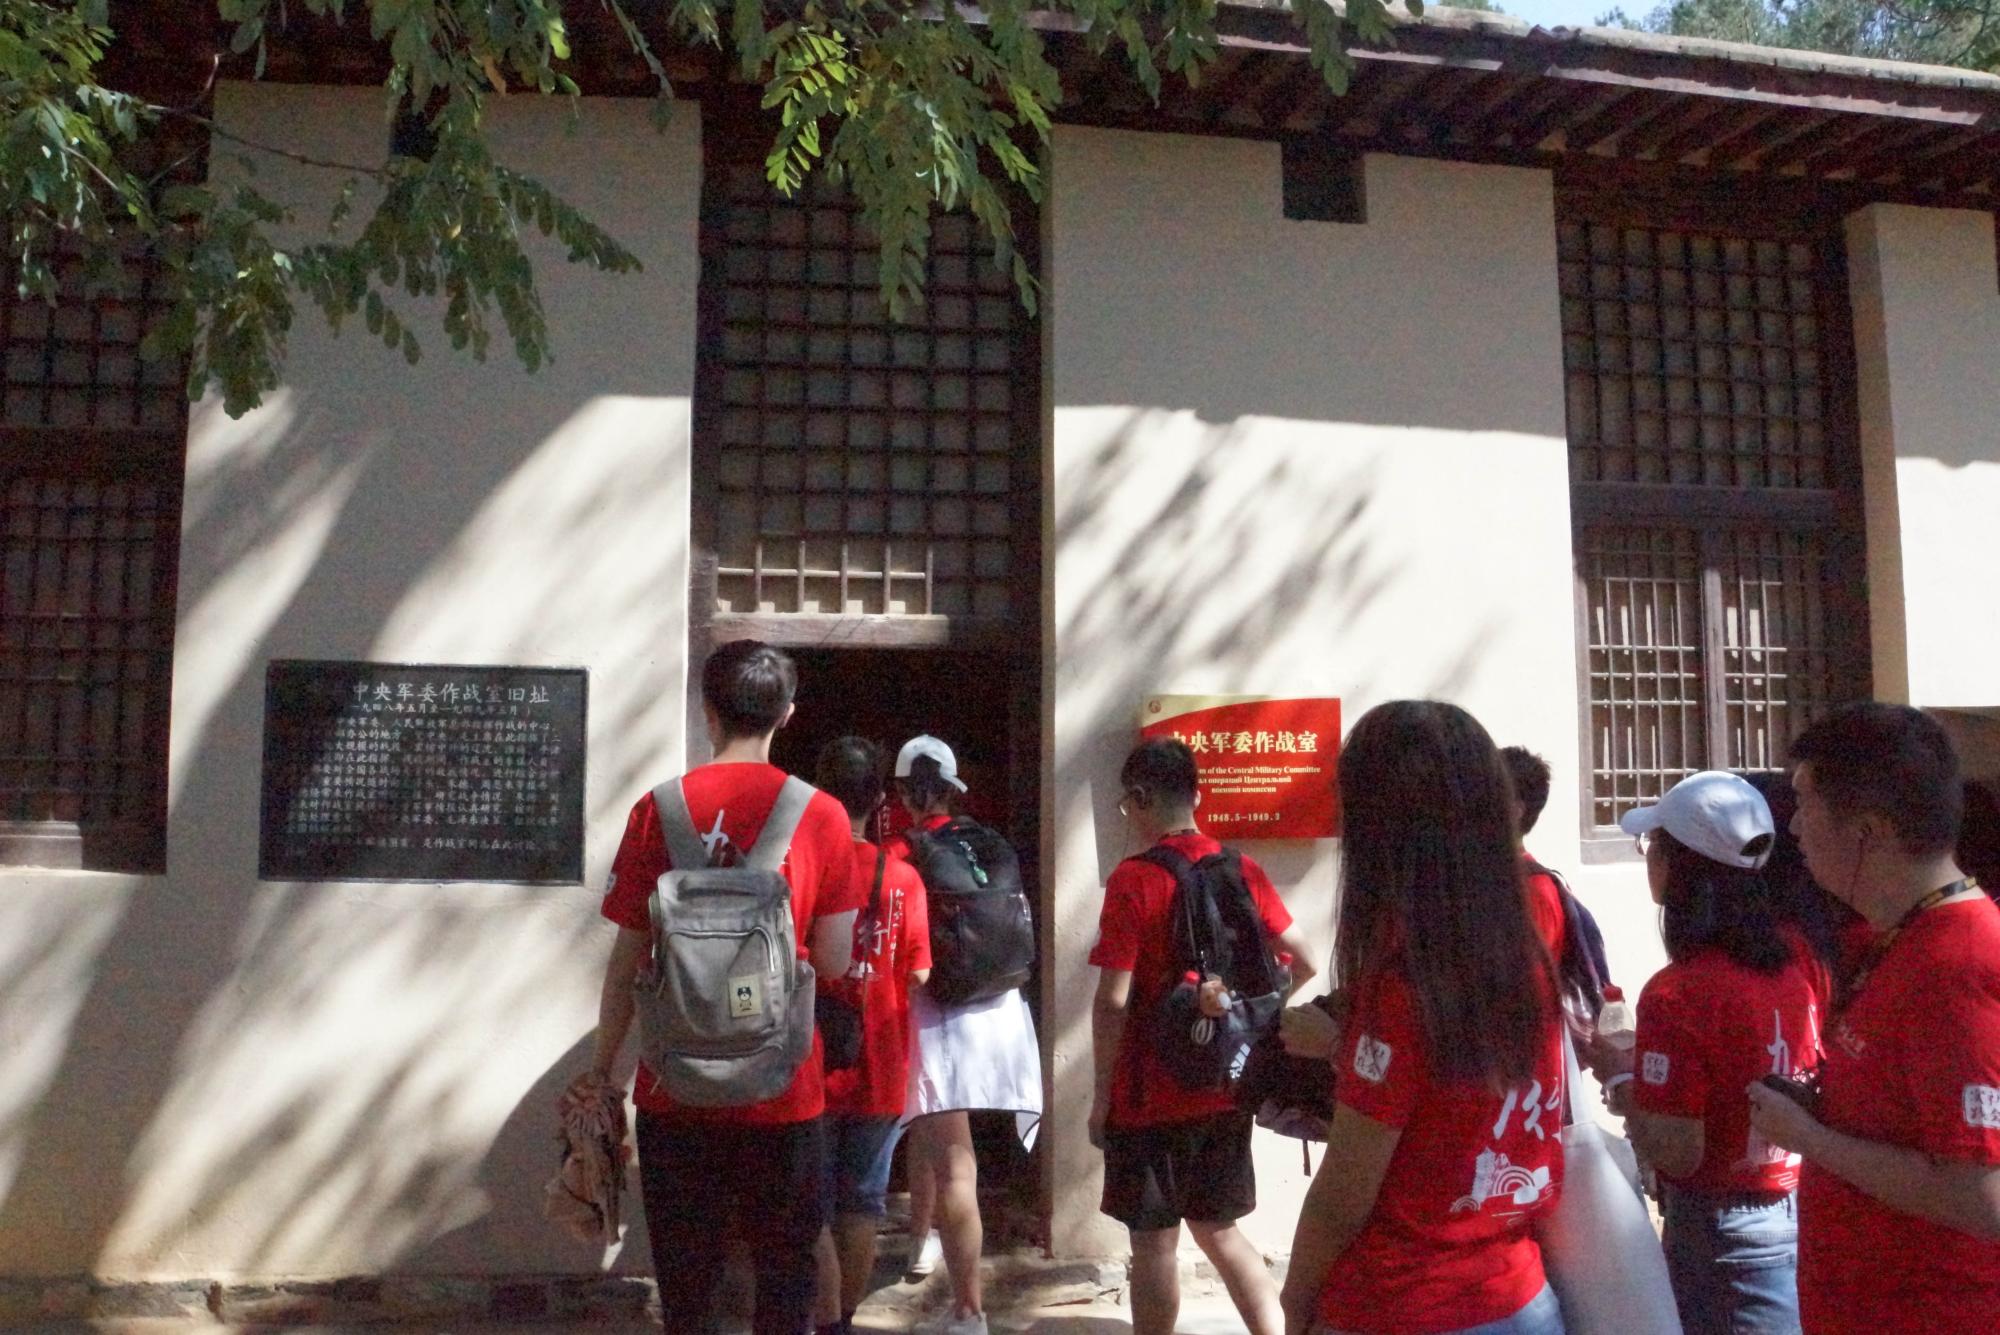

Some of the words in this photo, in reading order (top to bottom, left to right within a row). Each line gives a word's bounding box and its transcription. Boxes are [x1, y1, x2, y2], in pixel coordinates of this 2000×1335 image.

[353, 681, 551, 704] 中央军委作战室旧址
[1216, 767, 1227, 775] the
[1228, 766, 1254, 774] Central
[1255, 766, 1283, 776] Military
